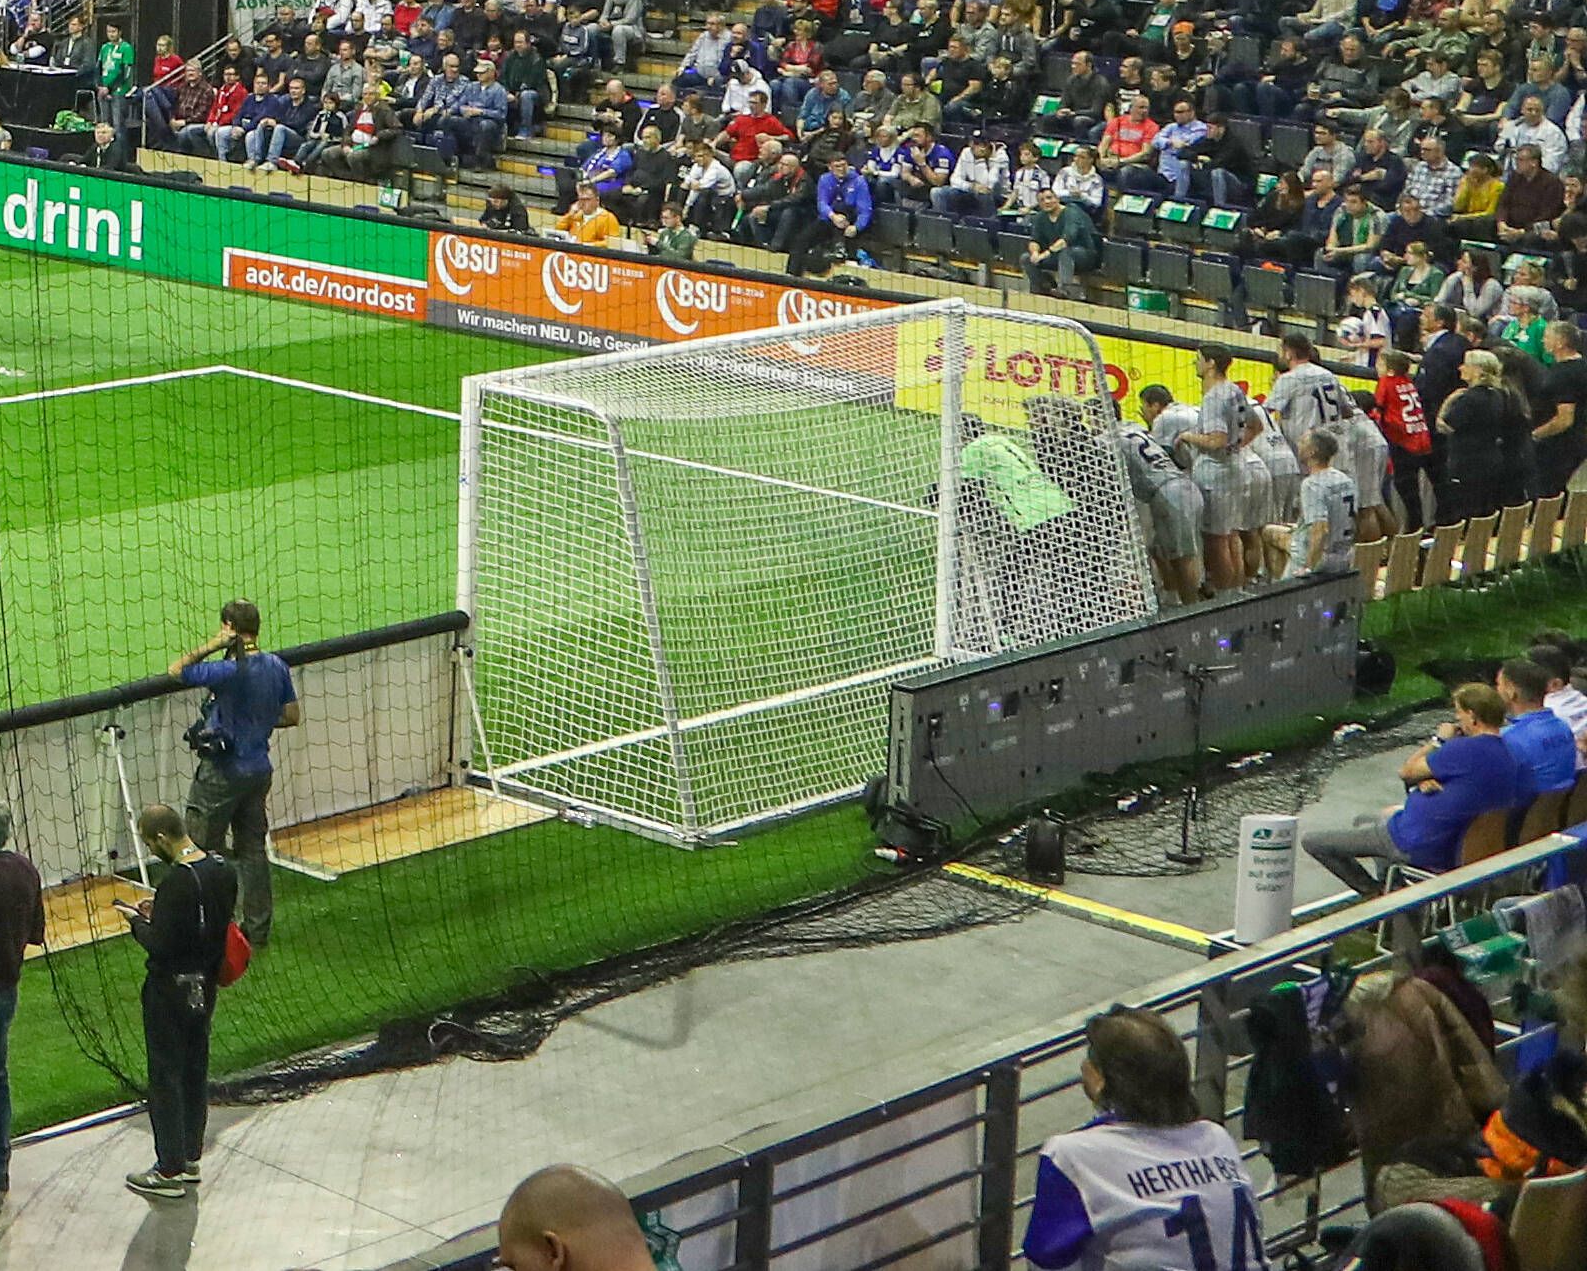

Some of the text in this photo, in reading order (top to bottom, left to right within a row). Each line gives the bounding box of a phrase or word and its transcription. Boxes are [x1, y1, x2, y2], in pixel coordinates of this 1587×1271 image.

[3, 177, 145, 261] drin!
[456, 241, 498, 276] BSU
[562, 260, 610, 294] BSU
[244, 265, 416, 314] aok.de/nordost
[678, 274, 728, 313] BSU
[456, 308, 479, 328] Wir
[481, 313, 537, 337] machen
[540, 322, 575, 345] NEU.
[578, 328, 602, 349] Die
[984, 343, 1130, 402] LOTTO
[1311, 384, 1343, 423] 15
[1126, 1160, 1215, 1199] HERTHA
